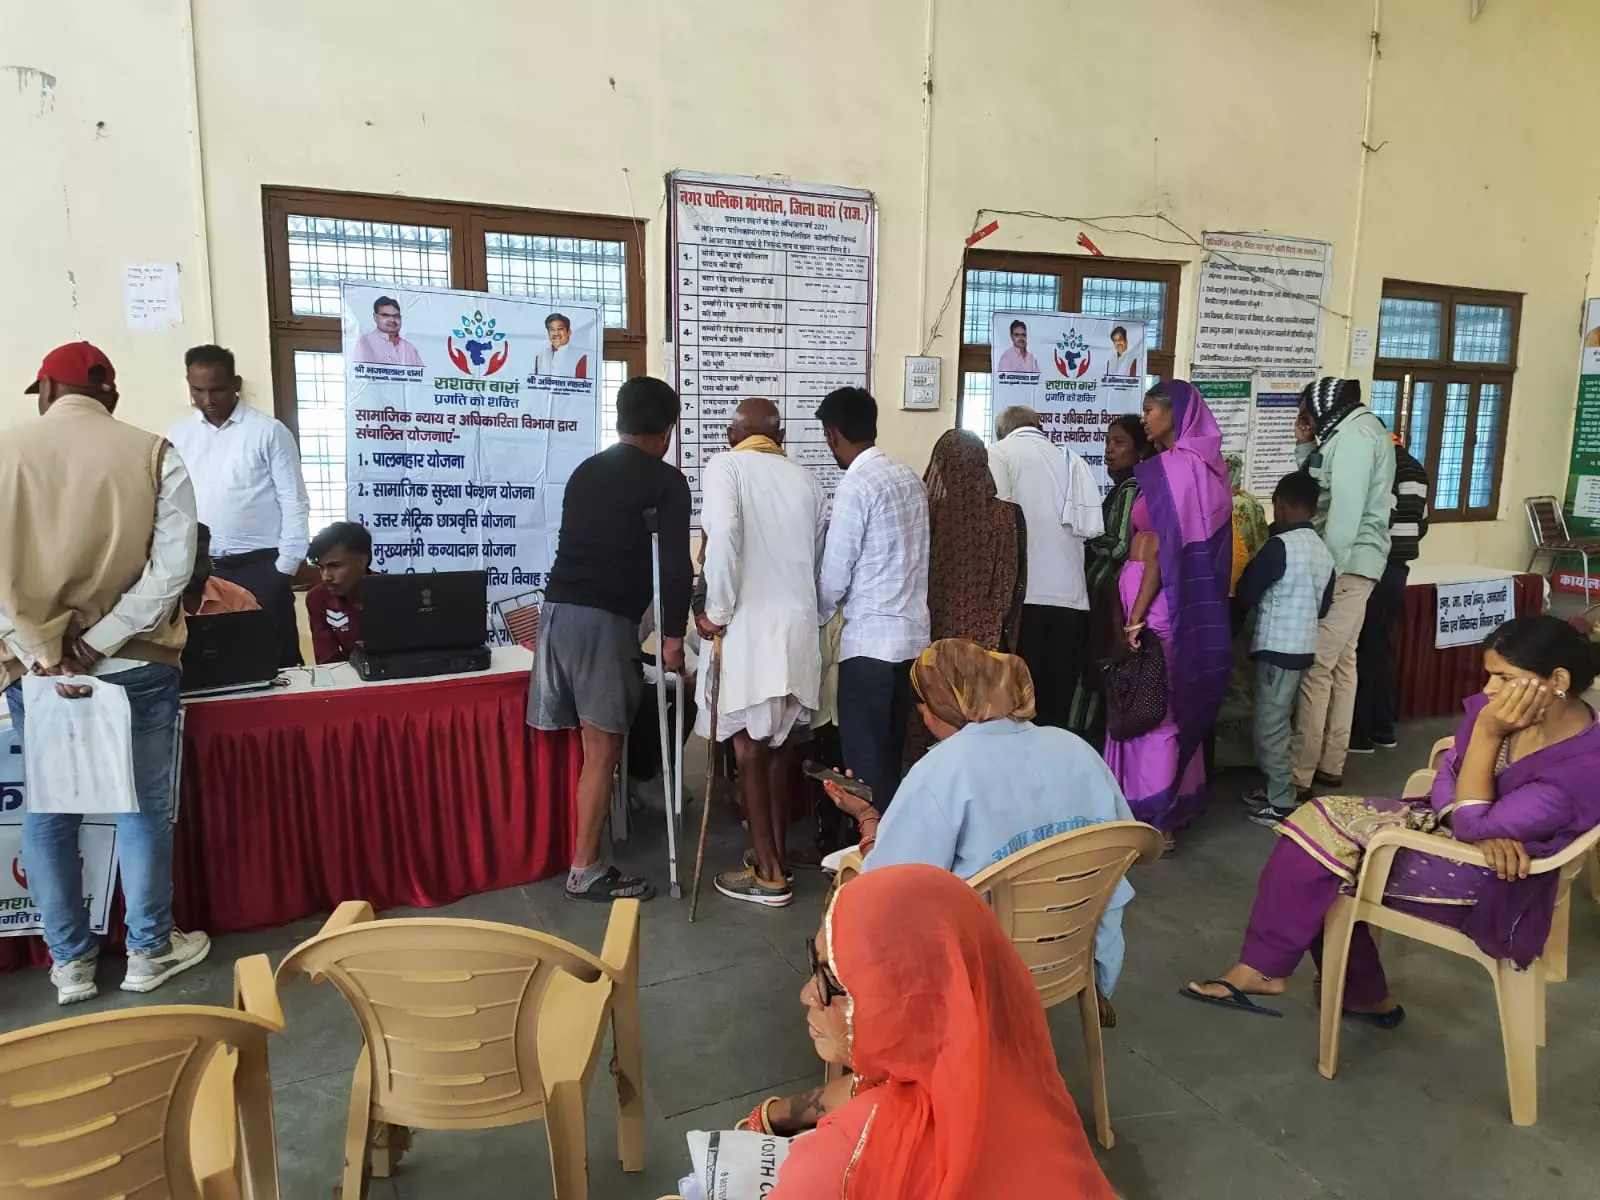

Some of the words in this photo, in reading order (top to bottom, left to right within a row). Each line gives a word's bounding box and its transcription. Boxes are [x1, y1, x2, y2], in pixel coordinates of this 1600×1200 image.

[680, 191, 702, 206] नगर
[704, 190, 743, 210] पालिका
[790, 197, 815, 216] जिला
[817, 201, 837, 218] बारां
[839, 202, 869, 224] (राज.)
[434, 377, 486, 392] सशक्त
[489, 378, 520, 394] बारां
[434, 394, 468, 406] प्रगति
[471, 394, 485, 407] को
[487, 394, 520, 409] शक्ति
[354, 406, 412, 423] सामाजिक
[416, 412, 444, 425] न्याय
[447, 414, 456, 425] व
[459, 410, 518, 429] अधिकारिता
[522, 414, 554, 431] विभाग
[557, 418, 578, 432] द्वारा
[1062, 408, 1099, 425] अधिकारिता
[355, 425, 404, 441] संचालित
[358, 453, 368, 466] 1.
[372, 452, 425, 468] पालनहार
[427, 449, 465, 469] योजना
[358, 483, 369, 497] 2.
[372, 478, 429, 498] सामाजिक
[432, 484, 462, 506] सुरक्षा
[465, 480, 497, 499] पेन्शन
[500, 481, 535, 500] योजना
[373, 513, 398, 528] उत्तर
[401, 507, 433, 533] मैट्रिक
[437, 509, 478, 534] छात्रवृत्ति
[481, 510, 516, 529] योजना
[373, 537, 425, 565] मुख्यमंत्री
[427, 543, 479, 558] कन्यादान
[481, 539, 516, 558] योजना
[512, 567, 541, 586] विवाह
[760, 1137, 776, 1177] YOUTH
